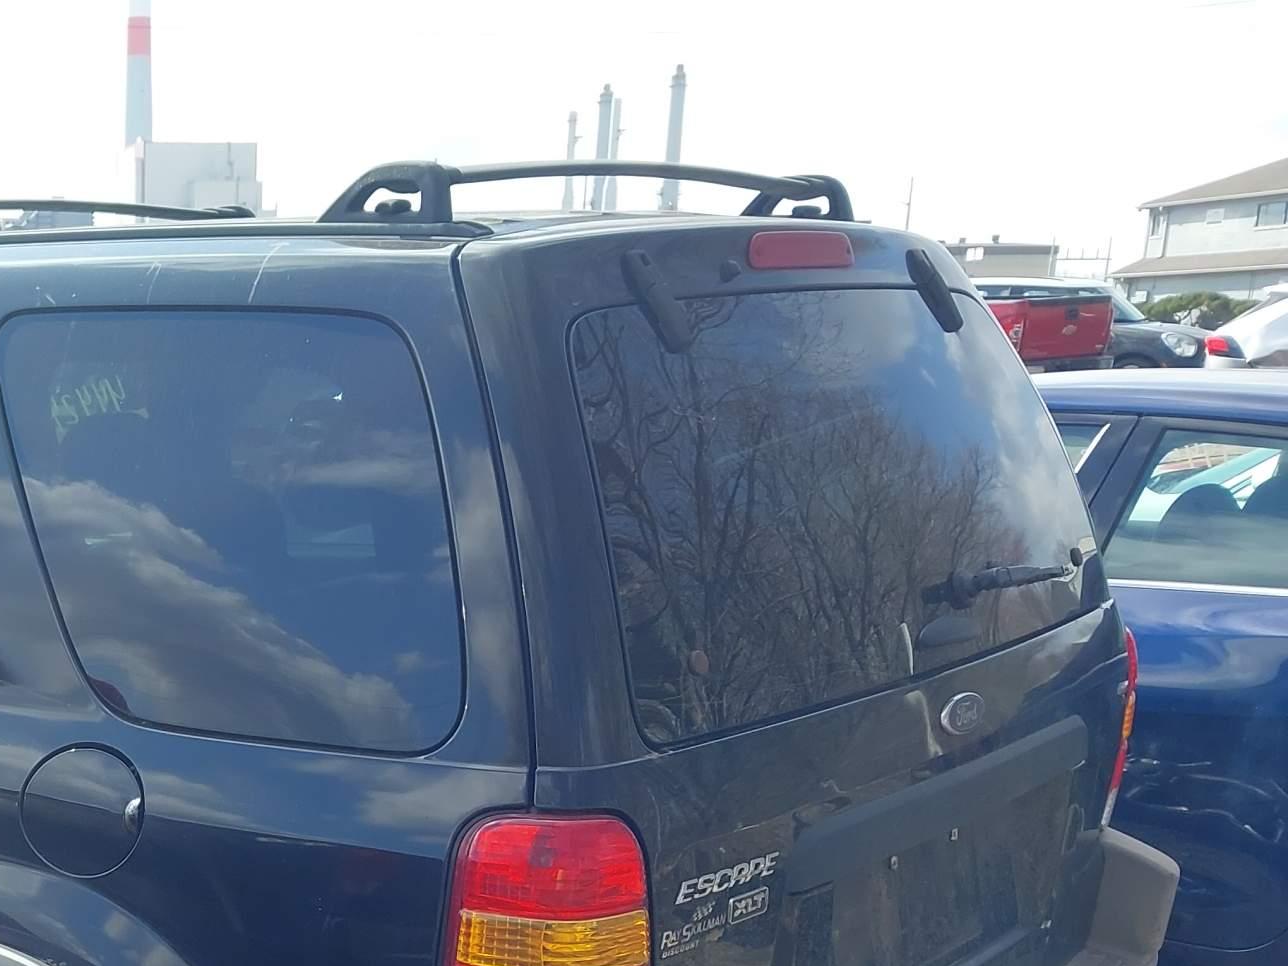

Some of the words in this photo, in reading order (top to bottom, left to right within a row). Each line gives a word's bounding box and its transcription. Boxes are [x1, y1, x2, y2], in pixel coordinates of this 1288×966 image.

[674, 851, 780, 905] ESCAPE
[733, 891, 765, 918] XLT
[661, 929, 682, 950] RAY
[661, 939, 700, 959] DISCOUNT
